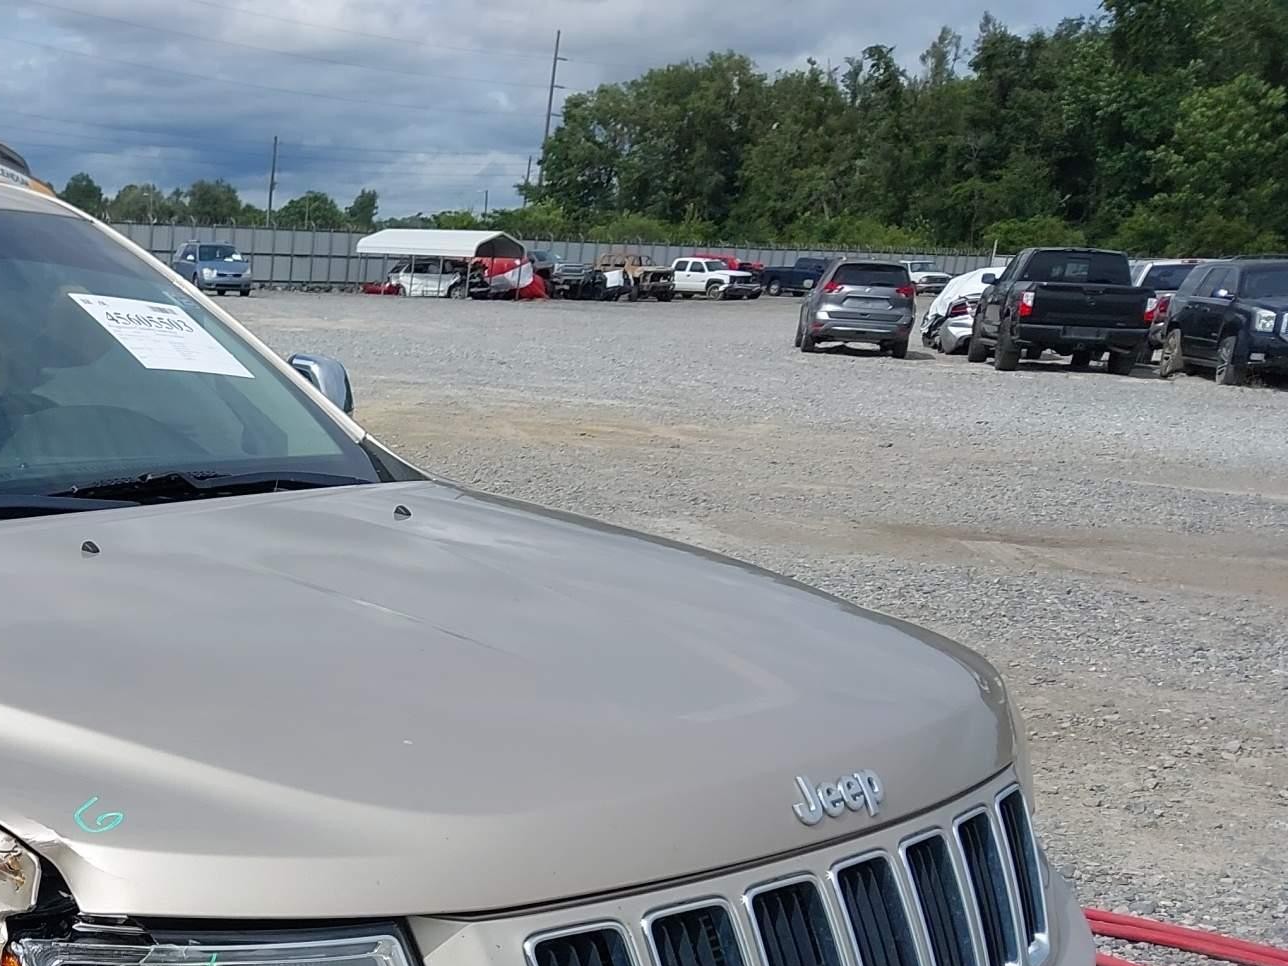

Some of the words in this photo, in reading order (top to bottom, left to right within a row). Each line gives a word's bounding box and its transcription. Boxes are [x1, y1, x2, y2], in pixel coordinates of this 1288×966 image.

[105, 311, 194, 333] 45605503
[74, 796, 123, 833] 6
[792, 769, 883, 826] Jeep
